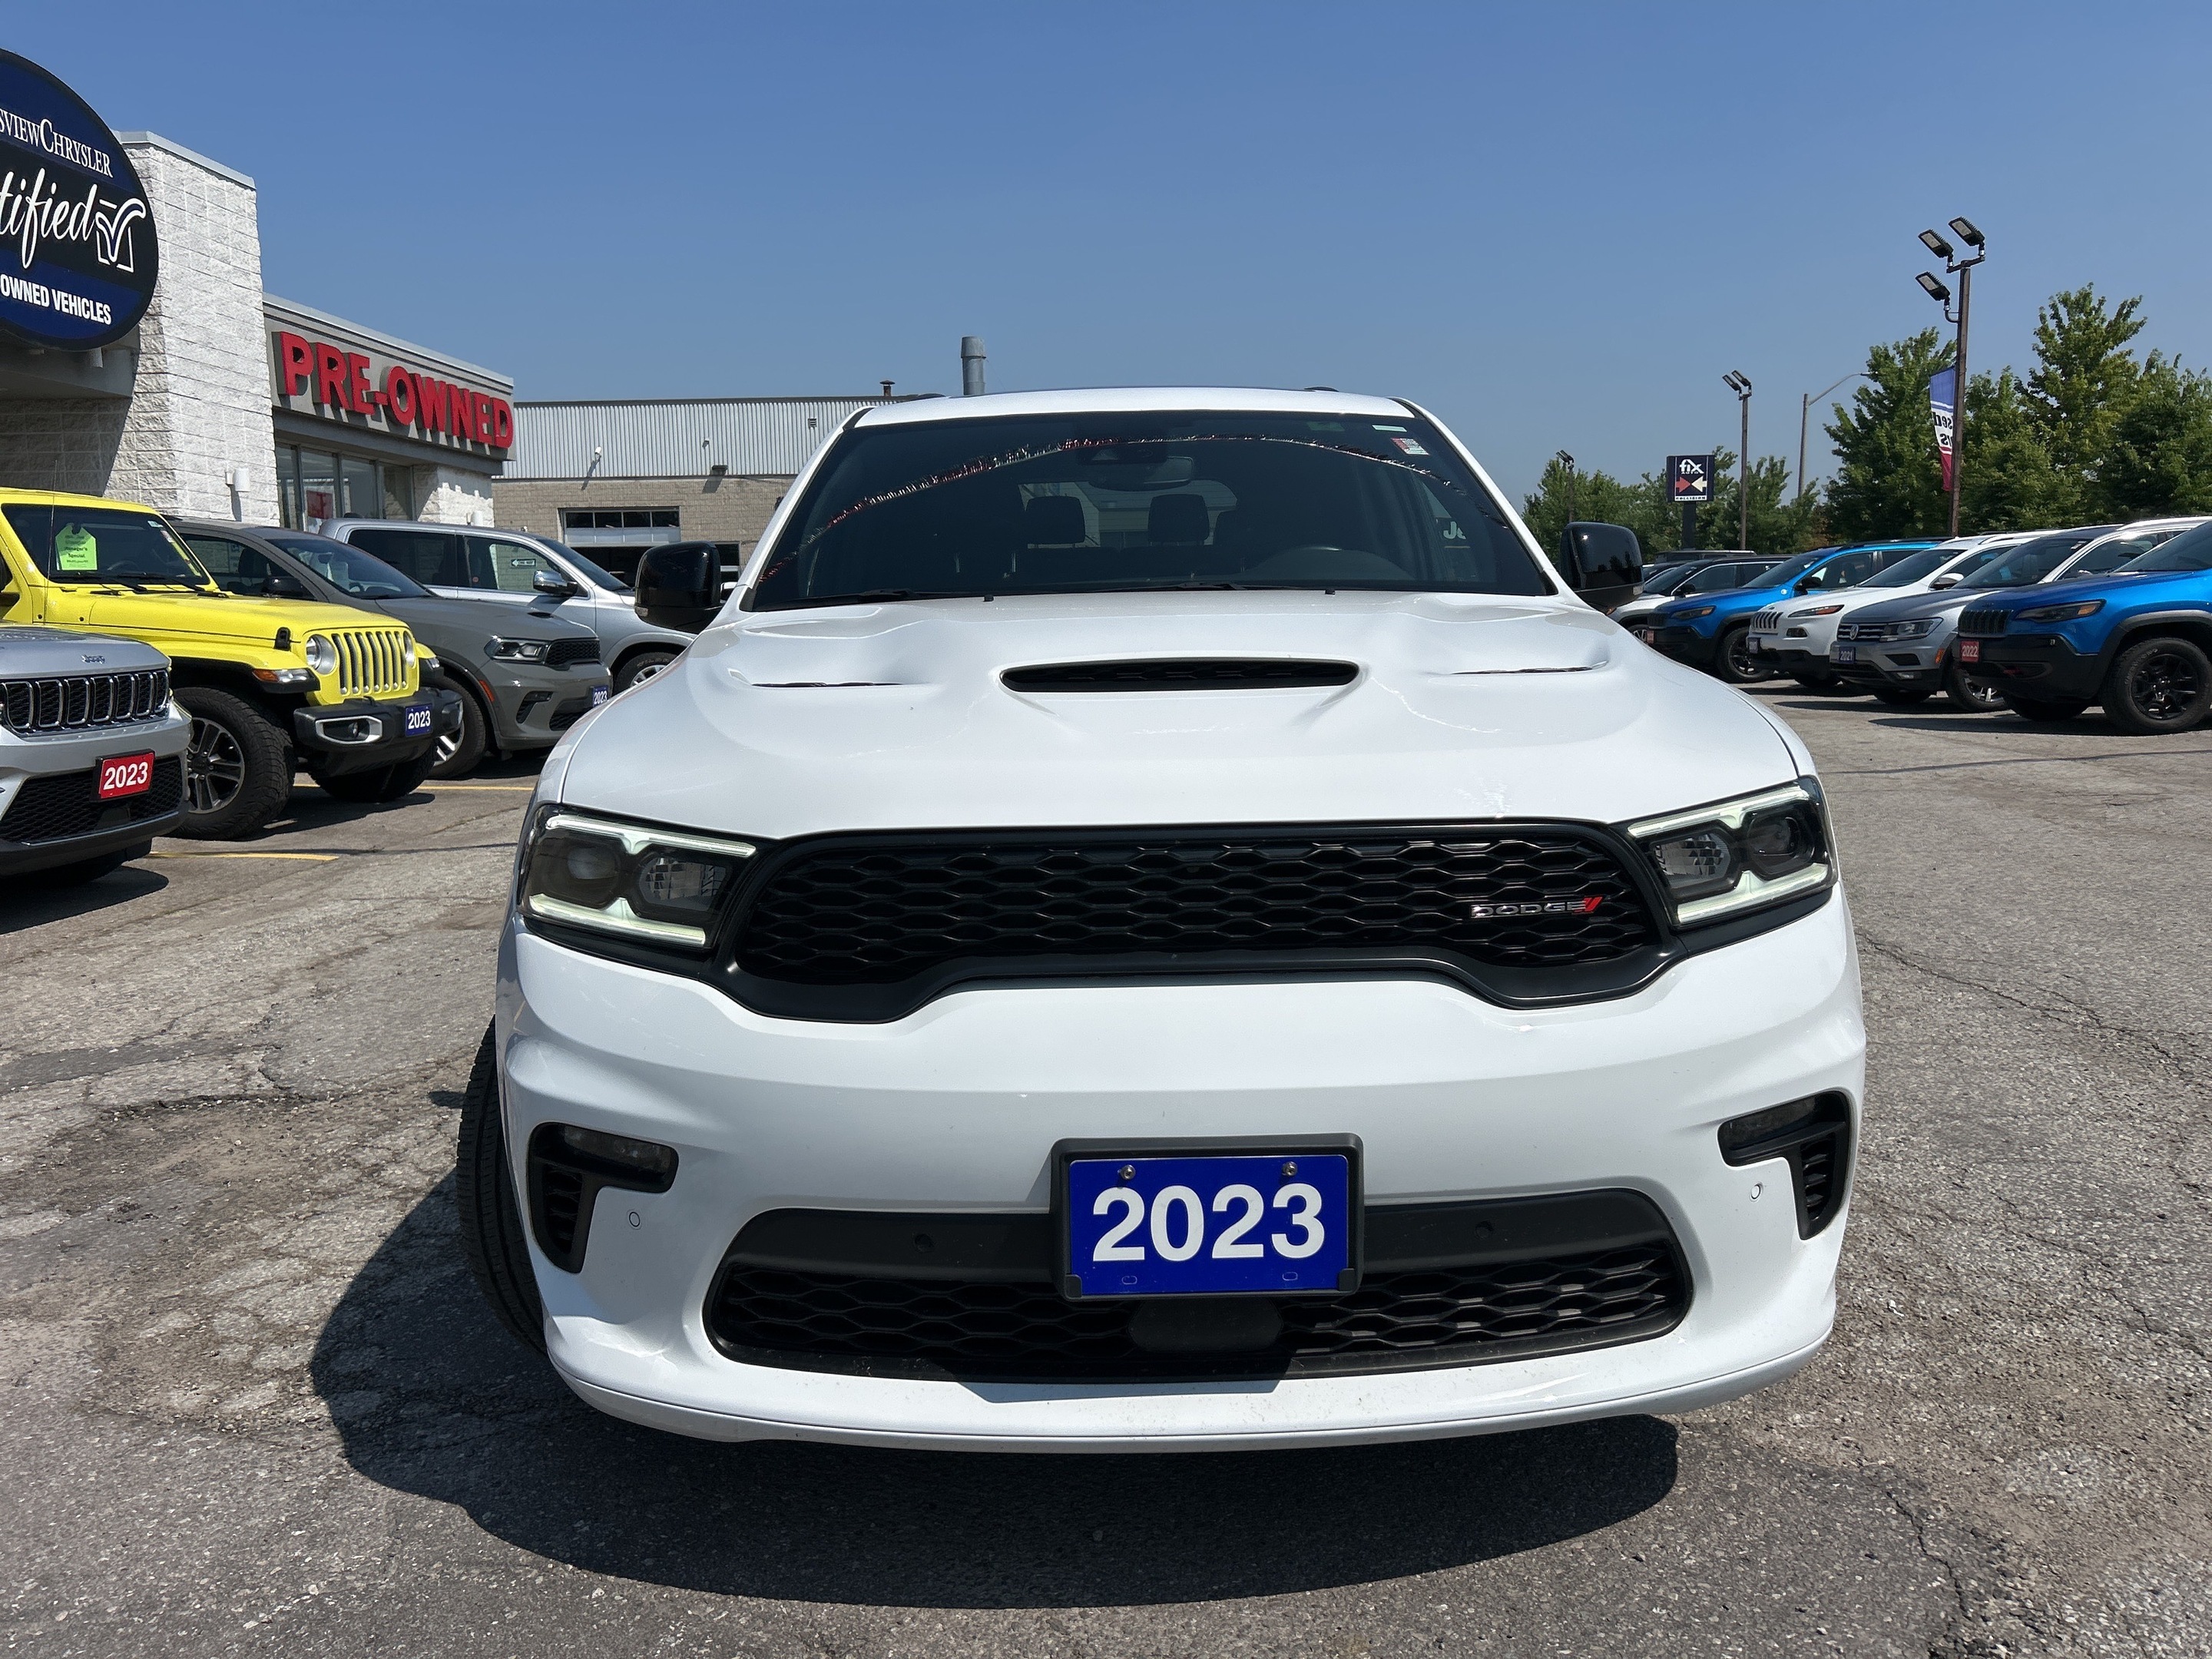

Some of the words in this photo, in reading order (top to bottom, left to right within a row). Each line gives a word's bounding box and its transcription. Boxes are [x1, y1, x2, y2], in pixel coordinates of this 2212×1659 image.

[0, 273, 50, 307] OWNED
[51, 288, 112, 325] VEHICLES
[273, 331, 514, 449] PRE-OWNED
[1679, 459, 1704, 474] fix
[1962, 645, 1979, 657] 2022
[408, 710, 431, 730] 2023
[103, 761, 148, 790] 2023
[1470, 900, 1587, 919] DODGE
[1092, 1183, 1325, 1262] 2023
